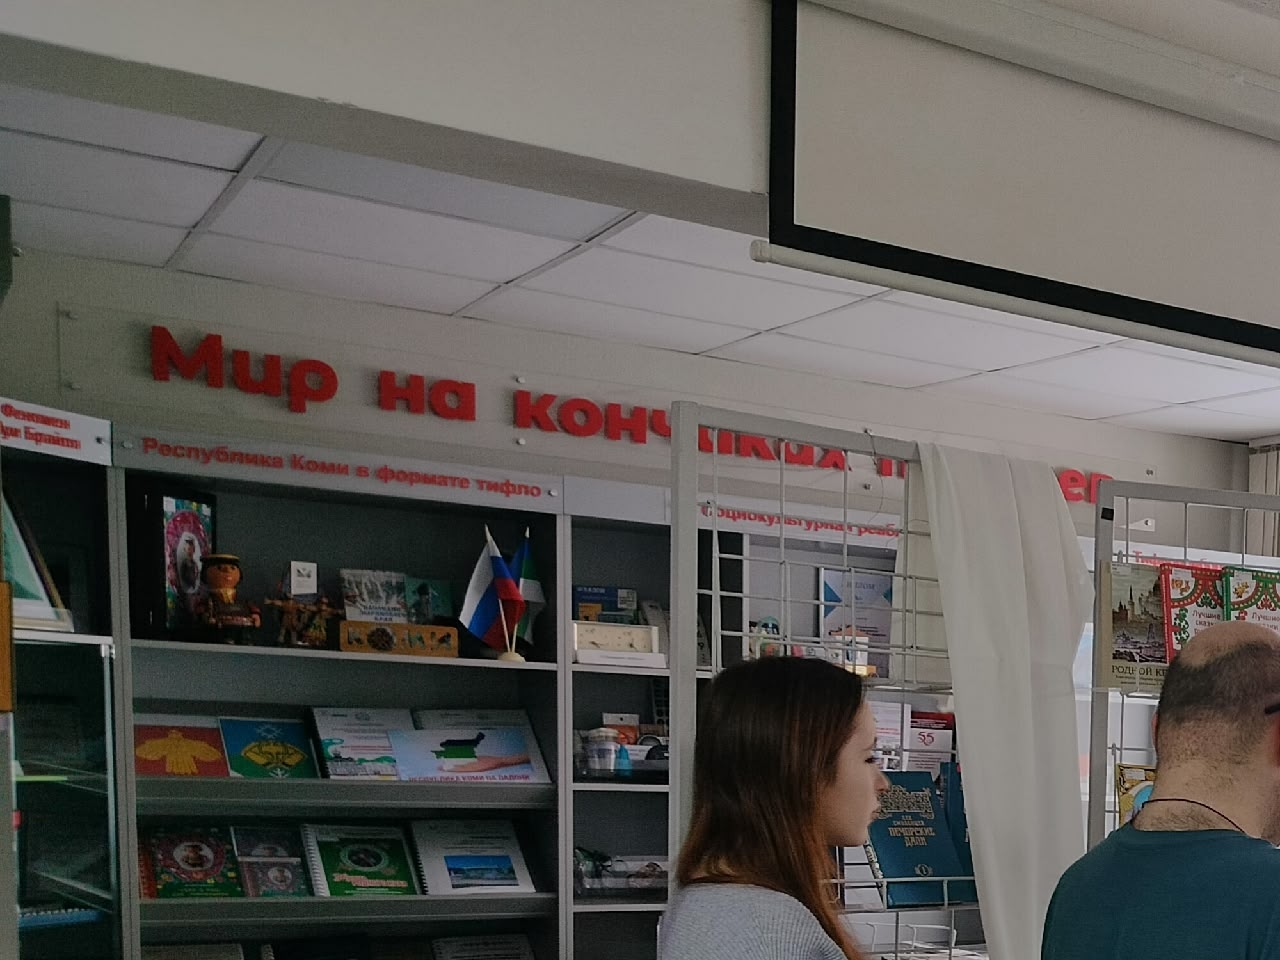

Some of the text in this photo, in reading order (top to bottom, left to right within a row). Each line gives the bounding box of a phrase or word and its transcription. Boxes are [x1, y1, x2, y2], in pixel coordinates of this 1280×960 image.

[151, 326, 339, 413] Мир
[377, 370, 477, 421] на
[141, 437, 542, 498] Республика Коми в формате тифло
